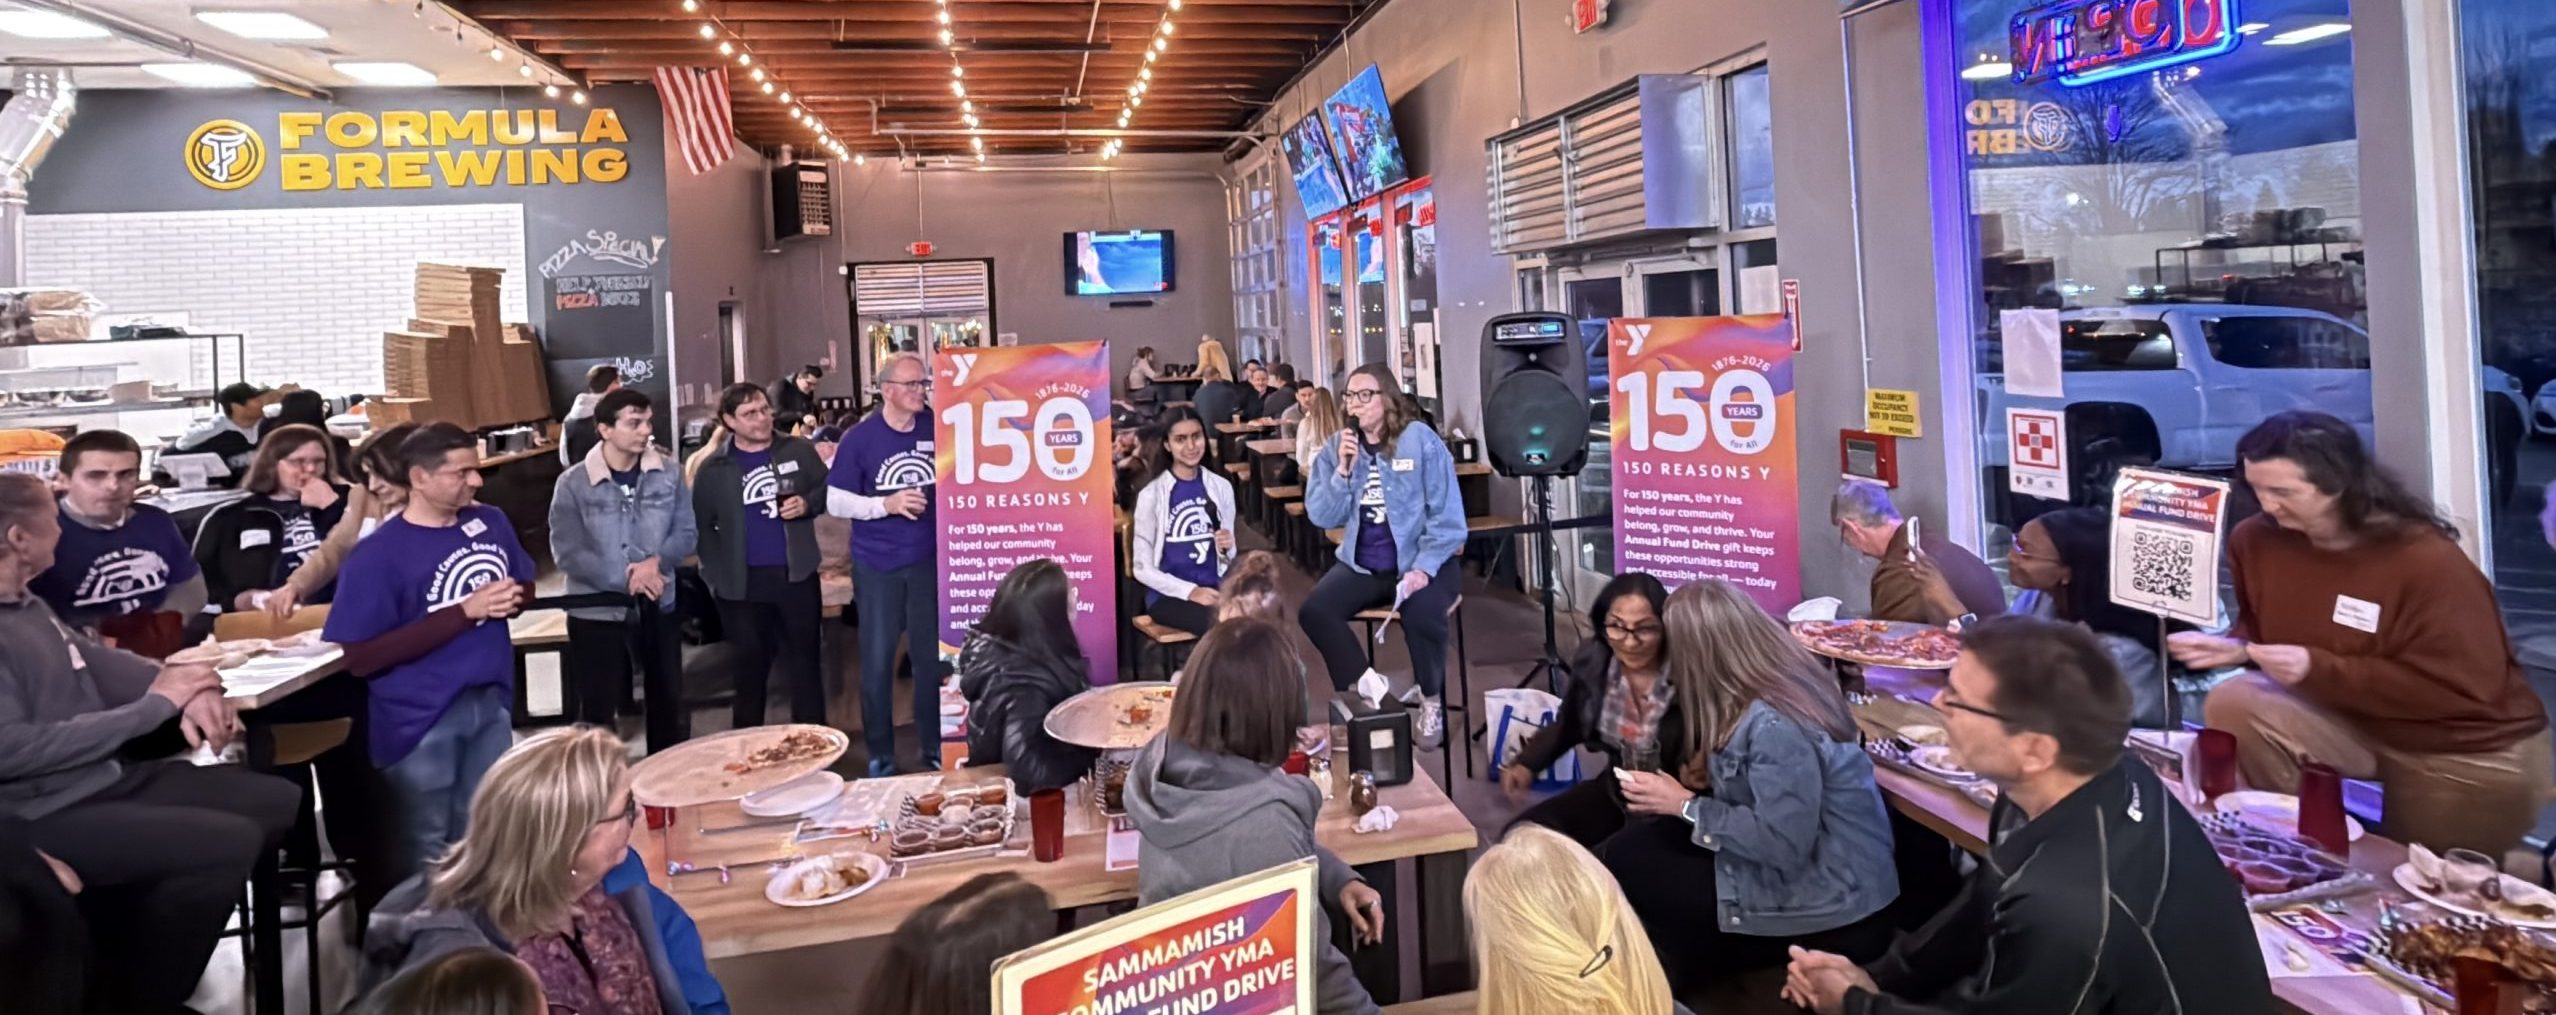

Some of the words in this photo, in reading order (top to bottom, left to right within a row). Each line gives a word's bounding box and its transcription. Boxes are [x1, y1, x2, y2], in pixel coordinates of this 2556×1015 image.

[279, 109, 628, 149] FORMULA
[280, 148, 629, 191] BREWING
[538, 239, 588, 279] PIZZA
[1615, 338, 1628, 347] the
[1616, 369, 1777, 455] 150
[1727, 406, 1758, 417] YEARS
[941, 396, 1095, 485] 150
[1049, 434, 1078, 444] YEARS
[1730, 440, 1743, 449] for
[1745, 440, 1758, 449] All
[1052, 466, 1064, 476] for
[1623, 461, 1652, 475] 150
[1661, 463, 1751, 480] REASONS
[1759, 467, 1770, 480] Y
[948, 494, 978, 509] 150
[986, 492, 1071, 508] REASONS
[1079, 491, 1089, 505] Y
[1623, 489, 1640, 499] For
[1641, 490, 1660, 500] 150
[1661, 492, 1694, 503] years,
[1695, 493, 1713, 503] the
[1713, 494, 1722, 503] Y
[1723, 494, 1743, 505] has
[1624, 505, 1657, 517] helped
[1658, 507, 1676, 517] our
[1677, 508, 1735, 522] community
[948, 524, 965, 534] For
[966, 523, 985, 534] 150
[986, 524, 1018, 536] years,
[1019, 522, 1036, 533] the
[1037, 522, 1045, 533] Y
[1046, 521, 1064, 532] has
[1624, 519, 1661, 533] belong,
[1662, 523, 1690, 534] grow,
[1692, 524, 1712, 535] and
[1713, 525, 1748, 538] thrive.
[1749, 527, 1775, 539] Your
[949, 540, 982, 552] helped
[984, 541, 1001, 549] our
[1002, 538, 1056, 550] community
[1624, 534, 1662, 546] Annual
[1663, 537, 1690, 549] Fund
[1692, 539, 1721, 551] Drive
[1723, 542, 1742, 554] gift
[1743, 543, 1775, 557] keeps
[949, 556, 986, 568] belong,
[988, 556, 1015, 569] grow,
[1016, 554, 1035, 565] and
[1069, 553, 1093, 563] Your
[1625, 550, 1652, 562] these
[1654, 552, 1723, 567] opportunities
[1723, 559, 1760, 572] strong
[949, 571, 986, 582] Annual
[1646, 567, 1697, 581] accessible
[1745, 576, 1777, 590] today
[949, 587, 977, 598] these
[950, 603, 969, 614] and
[1076, 601, 1095, 613] day
[950, 618, 970, 630] and
[1083, 916, 1245, 994] SAMMAMISH
[1057, 956, 1220, 1015] OMMUNITY
[1219, 938, 1274, 976] YMA
[1223, 957, 1296, 1002] DRIVE
